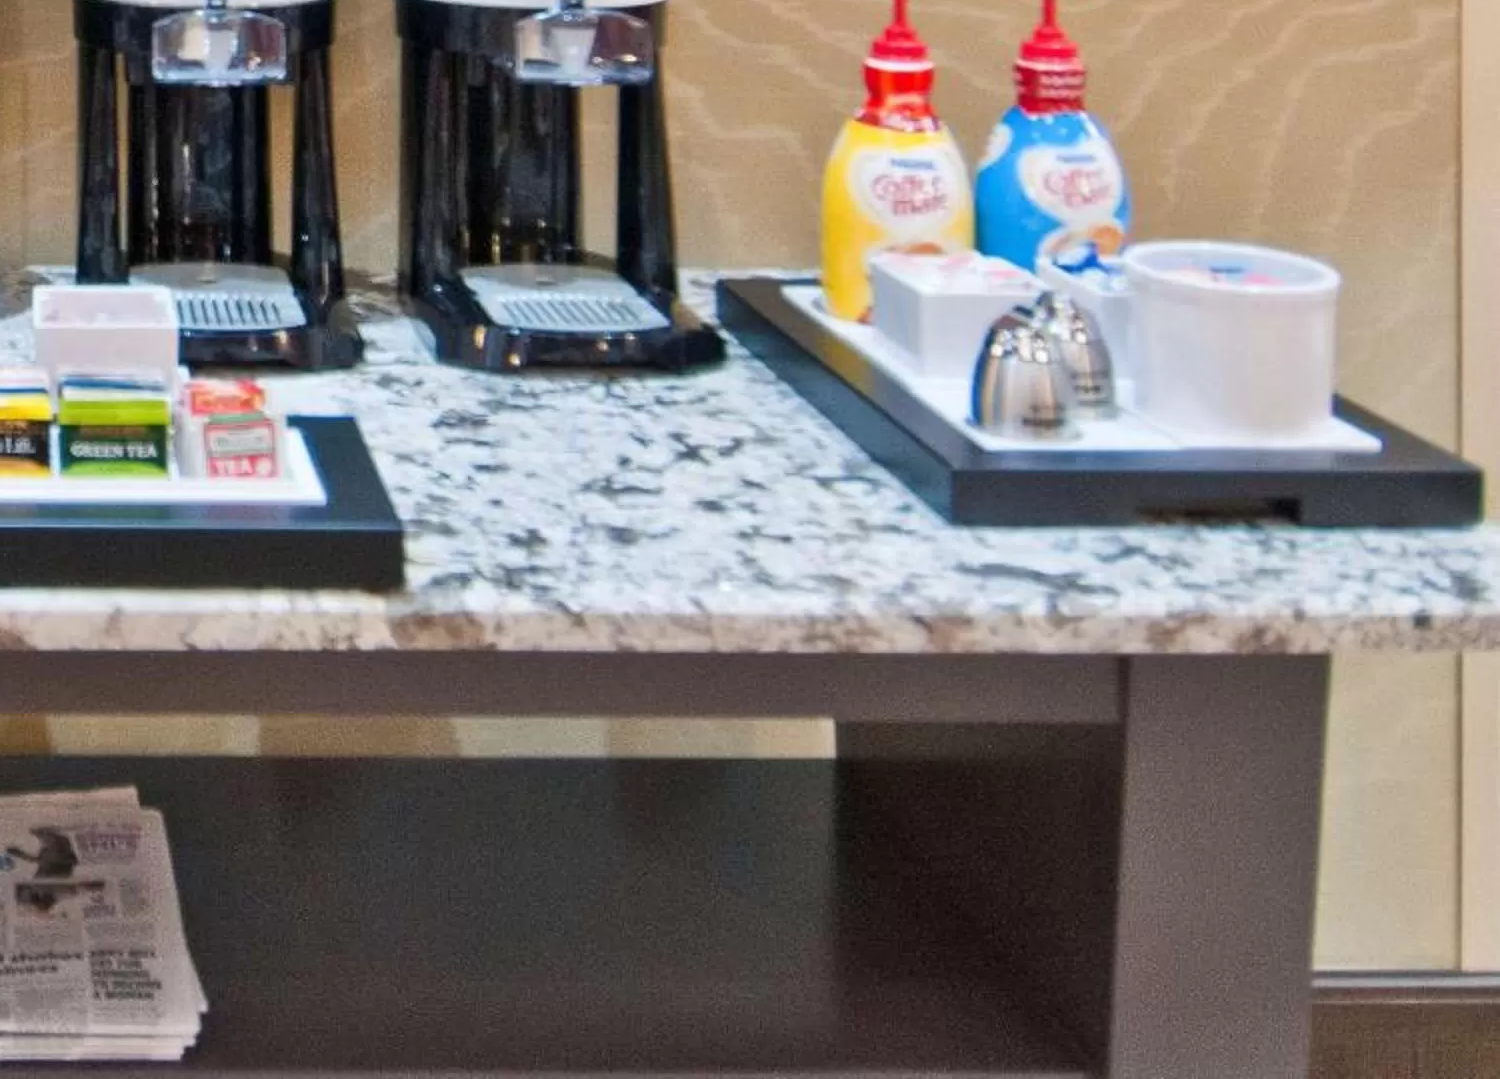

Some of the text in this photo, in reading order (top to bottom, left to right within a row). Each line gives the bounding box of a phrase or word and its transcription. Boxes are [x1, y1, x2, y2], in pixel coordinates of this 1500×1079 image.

[70, 440, 158, 458] GREEN TEA
[214, 457, 254, 474] TEA
